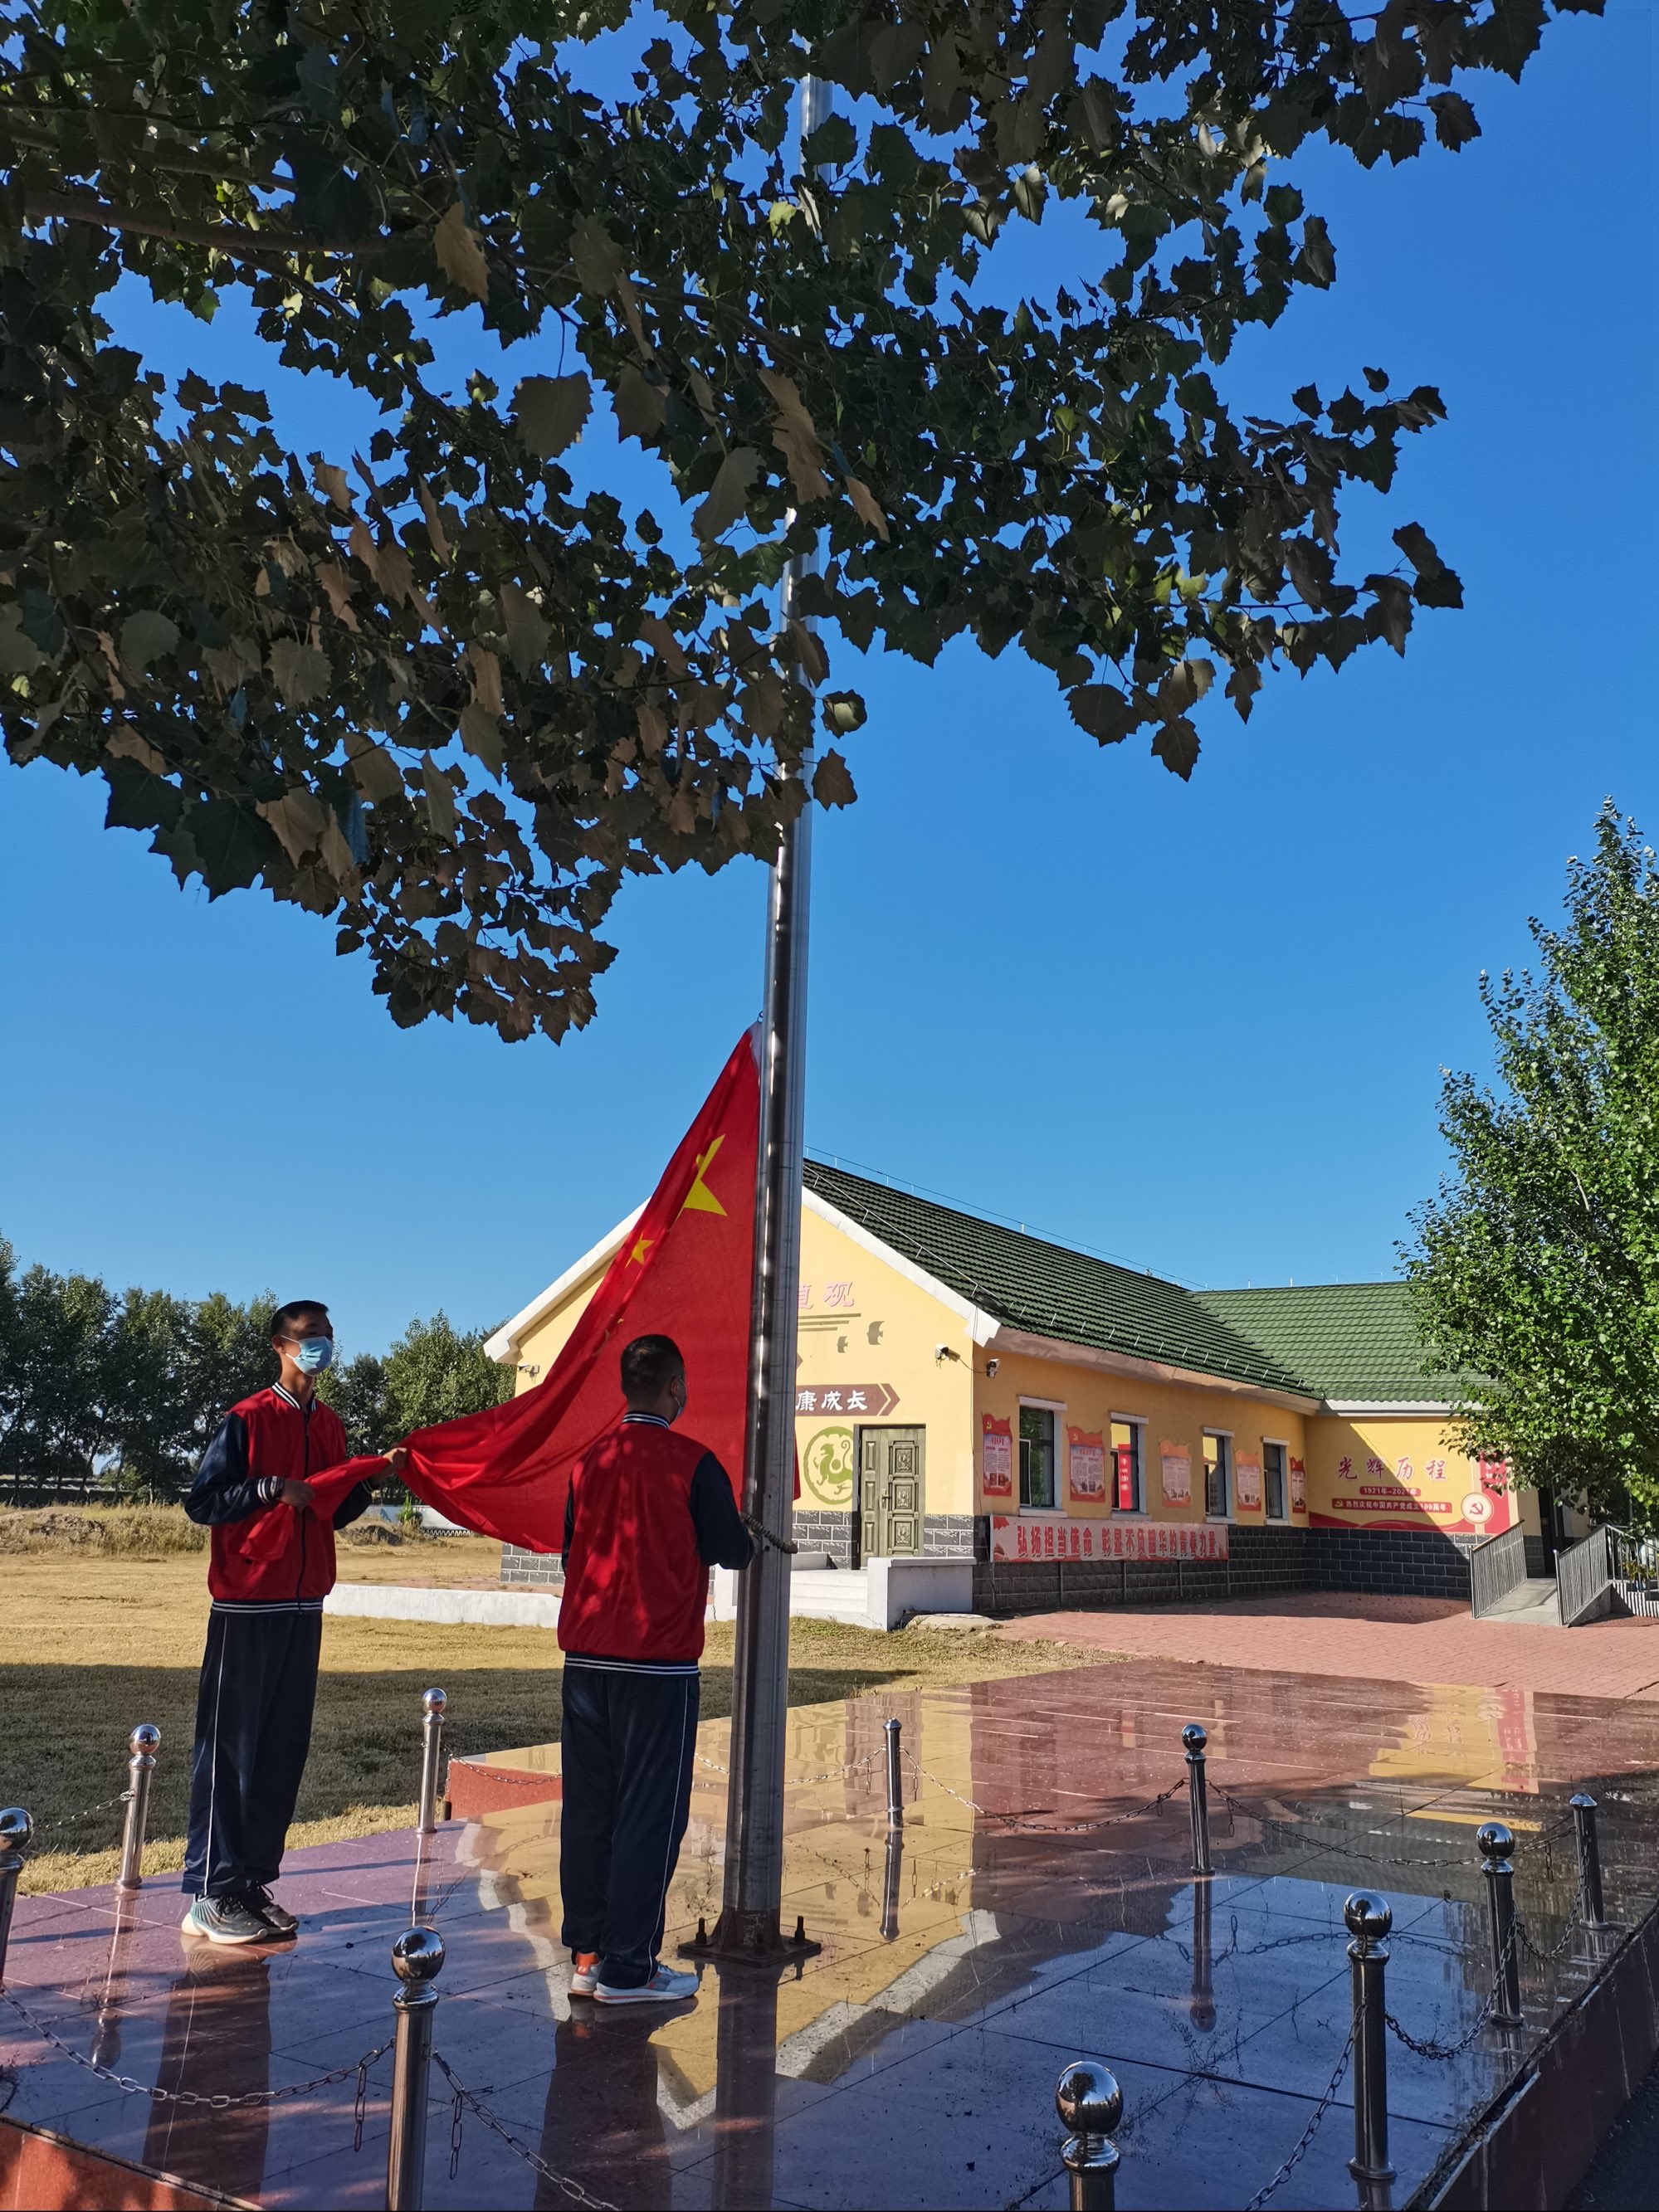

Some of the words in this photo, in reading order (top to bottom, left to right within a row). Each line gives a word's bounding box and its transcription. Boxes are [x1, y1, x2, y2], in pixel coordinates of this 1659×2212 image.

[796, 1390, 868, 1411] 康成长
[1338, 1456, 1447, 1481] 光辉历程
[1017, 1525, 1092, 1556] 弘扬担当使命
